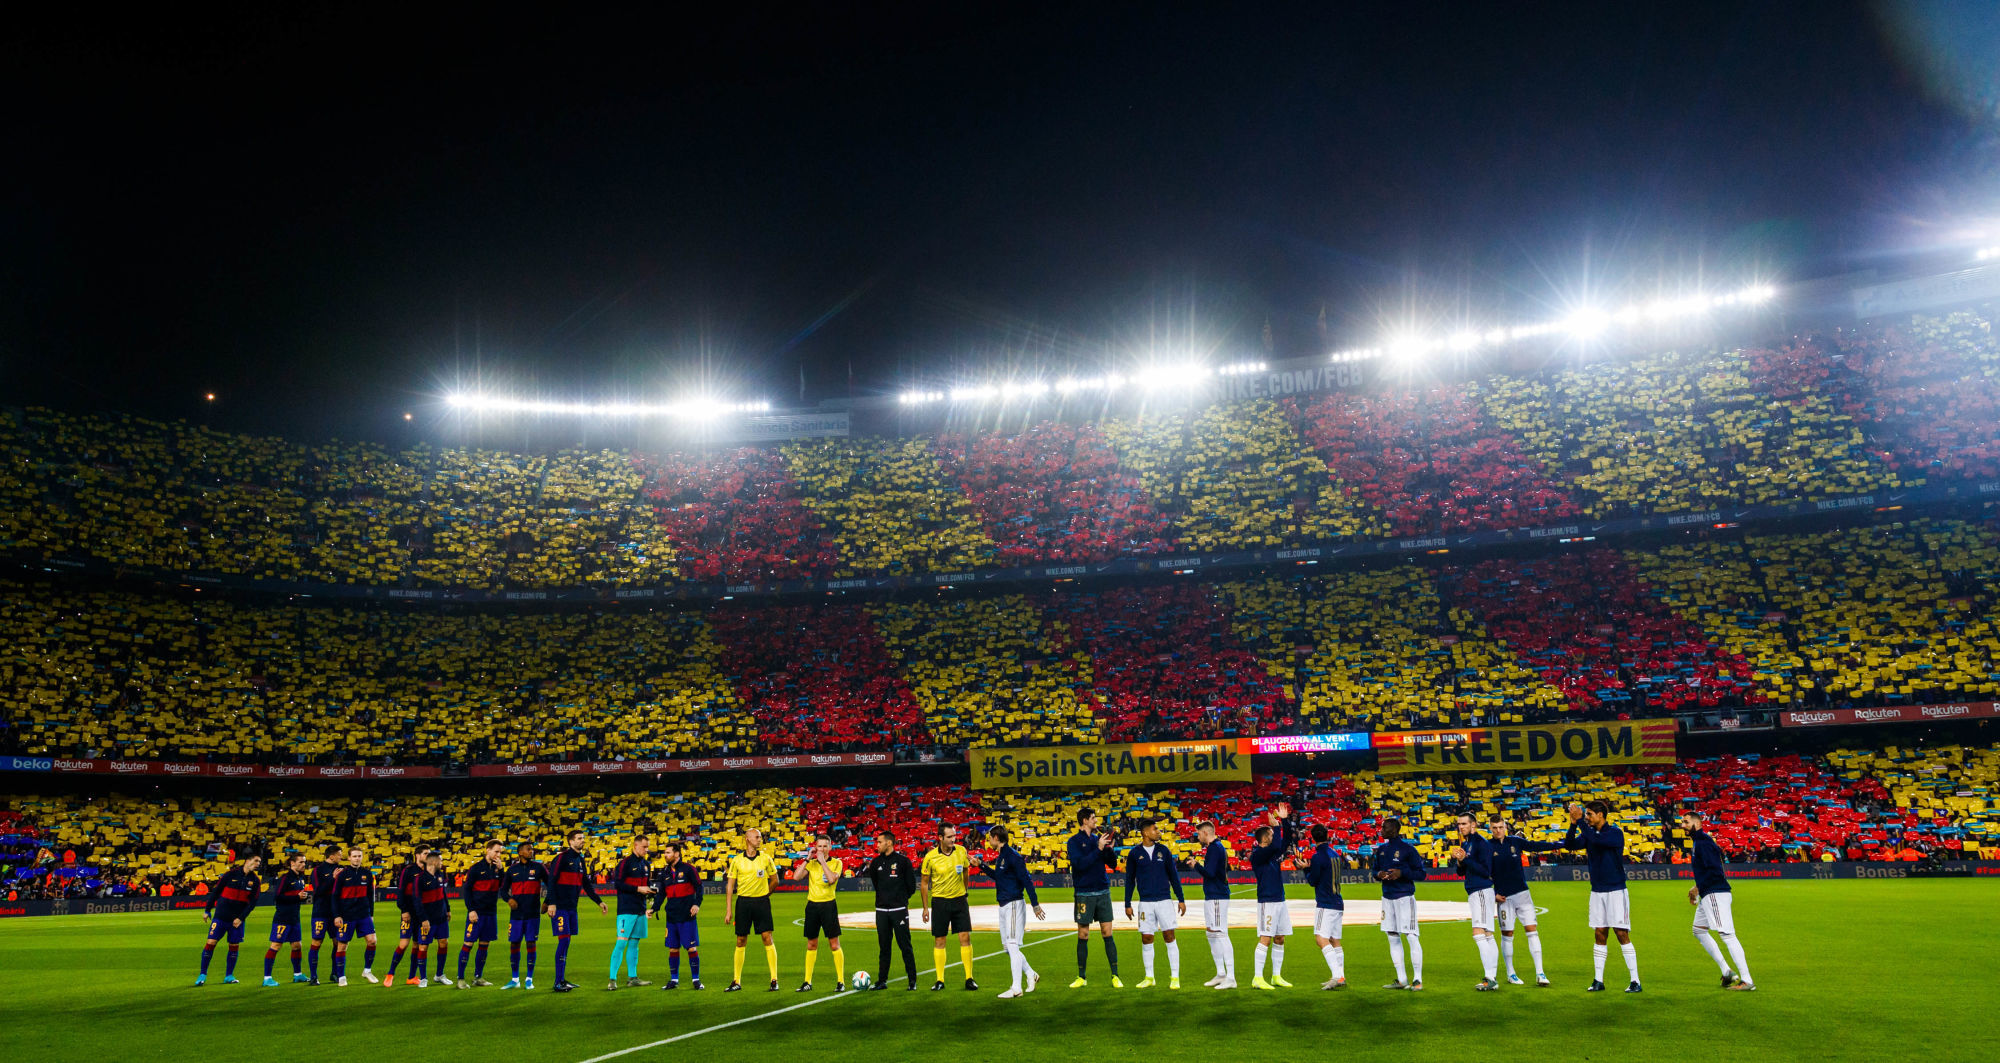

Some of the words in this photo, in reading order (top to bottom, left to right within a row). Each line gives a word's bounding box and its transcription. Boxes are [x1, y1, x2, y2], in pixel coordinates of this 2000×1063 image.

[1217, 365, 1363, 400] NIKE.COM/FCB
[1818, 496, 1874, 510] NIKE.COM/FCB
[1855, 709, 1900, 719] Rakuten
[1921, 705, 1969, 715] Rakuten
[1790, 712, 1835, 722] Rakuten
[1252, 737, 1312, 745] BLAUGRANA
[1403, 735, 1441, 744] ESTRELLA
[1442, 733, 1467, 742] DAMM
[1414, 726, 1634, 765] FREEDOM
[723, 758, 753, 767] Rakuten
[767, 757, 797, 765] Rakuten
[811, 755, 841, 763] Rakuten
[855, 754, 885, 762] Rakuten
[13, 758, 50, 769] beko
[54, 760, 93, 769] Rakuten
[110, 762, 147, 771] Rakuten
[164, 763, 200, 772] Rakuten
[550, 763, 579, 772] Rakuten
[593, 762, 622, 771] Rakuten
[637, 761, 666, 770] Rakuten
[680, 760, 710, 769] Rakuten
[982, 745, 1238, 782] #SpainSitAndTalk
[217, 765, 253, 773] Rakuten
[320, 767, 354, 775] Rakuten
[371, 767, 404, 775] Rakuten
[507, 764, 536, 773] Rakuten
[1625, 868, 1671, 880] estes!
[1855, 865, 1907, 878] Bones
[1341, 874, 1364, 884] nes
[703, 884, 722, 894] nes
[86, 902, 125, 914] Bones
[129, 900, 170, 912] festes!
[1501, 910, 1506, 920] 8
[558, 916, 564, 926] 3
[621, 919, 625, 928] 1
[1266, 915, 1272, 926] 2
[211, 922, 217, 930] 9
[277, 925, 286, 934] 17
[315, 921, 324, 931] 15
[400, 921, 410, 930] 20
[467, 923, 473, 933] 4
